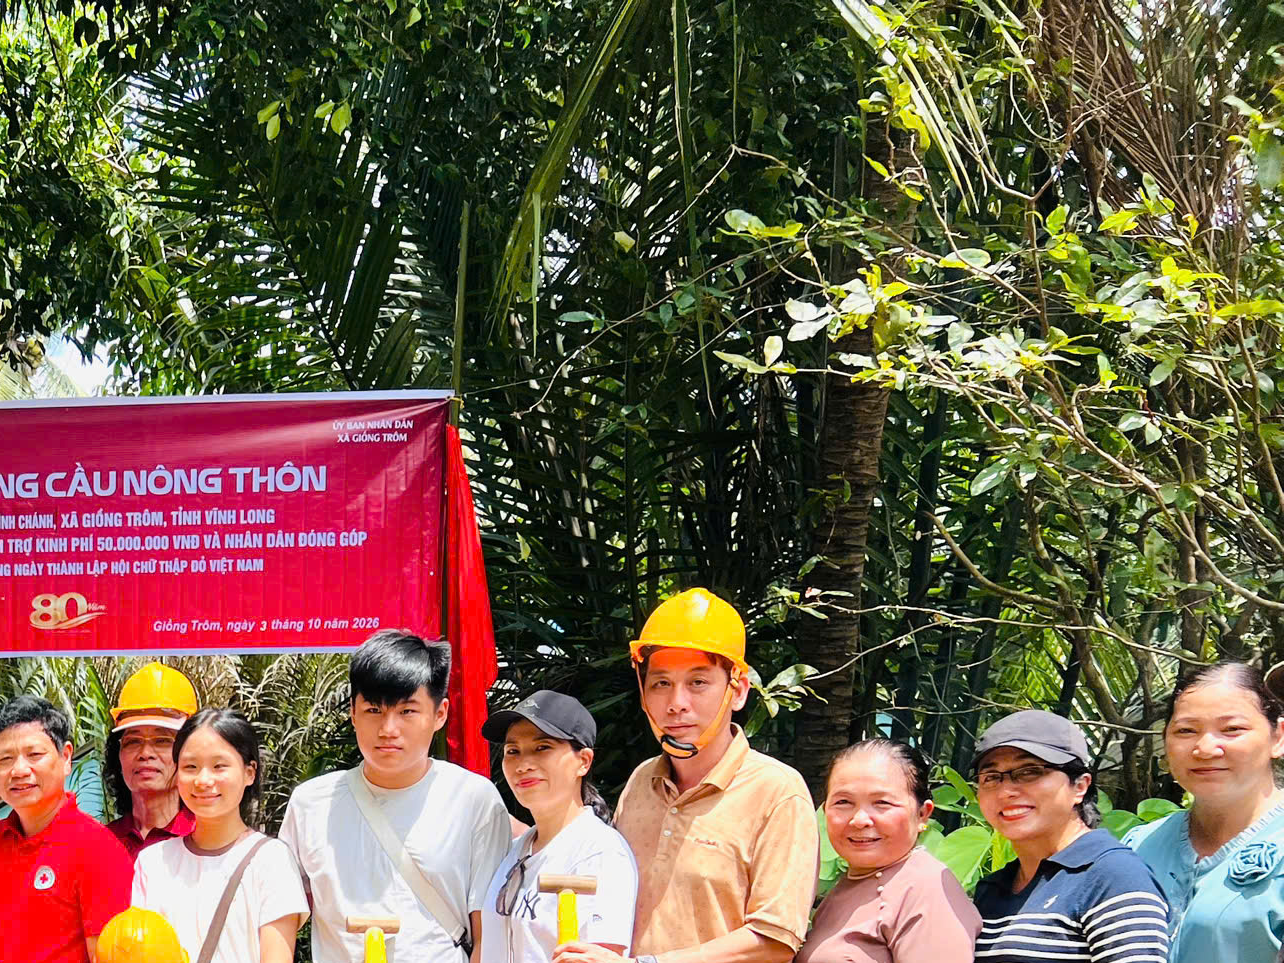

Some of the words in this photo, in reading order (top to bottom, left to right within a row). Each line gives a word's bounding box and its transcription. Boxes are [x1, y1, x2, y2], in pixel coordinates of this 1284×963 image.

[346, 421, 365, 430] BAN
[382, 430, 408, 442] TRÔM
[45, 462, 116, 498] CẦU
[123, 464, 222, 496] NÔNG
[228, 460, 328, 494] THÔN
[18, 512, 56, 531] CHÁNH,
[61, 510, 79, 528] XÃ
[126, 508, 168, 528] TRÔM,
[171, 506, 202, 526] TỈNH
[205, 508, 236, 526] VĨNH
[240, 508, 276, 524] LONG
[8, 536, 32, 556] TRỢ
[36, 538, 68, 552] KINH
[71, 534, 94, 552] PHÍ
[97, 535, 169, 552] 50.000.000
[172, 534, 200, 550] VNĐ
[204, 532, 221, 550] VÀ
[224, 530, 263, 549] NHÂN
[266, 530, 294, 548] DÂN
[298, 529, 336, 548] ĐÓNG
[339, 529, 368, 548] GÓP
[14, 560, 44, 576] NGÀY
[46, 558, 84, 576] THÀNH
[86, 558, 108, 577] LẬP
[111, 558, 130, 576] HỘI
[132, 557, 158, 574] CHỮ
[159, 558, 188, 576] THẬP
[190, 556, 207, 572] ĐỎ
[210, 556, 234, 575] VIỆT
[237, 558, 264, 572] NAM
[30, 592, 88, 626] 80
[191, 618, 223, 632] Trôm,
[226, 618, 256, 632] ngày
[260, 621, 267, 632] 3
[271, 617, 304, 632] tháng
[308, 618, 321, 629] 10
[324, 617, 349, 630] năm
[352, 616, 380, 629] 2026
